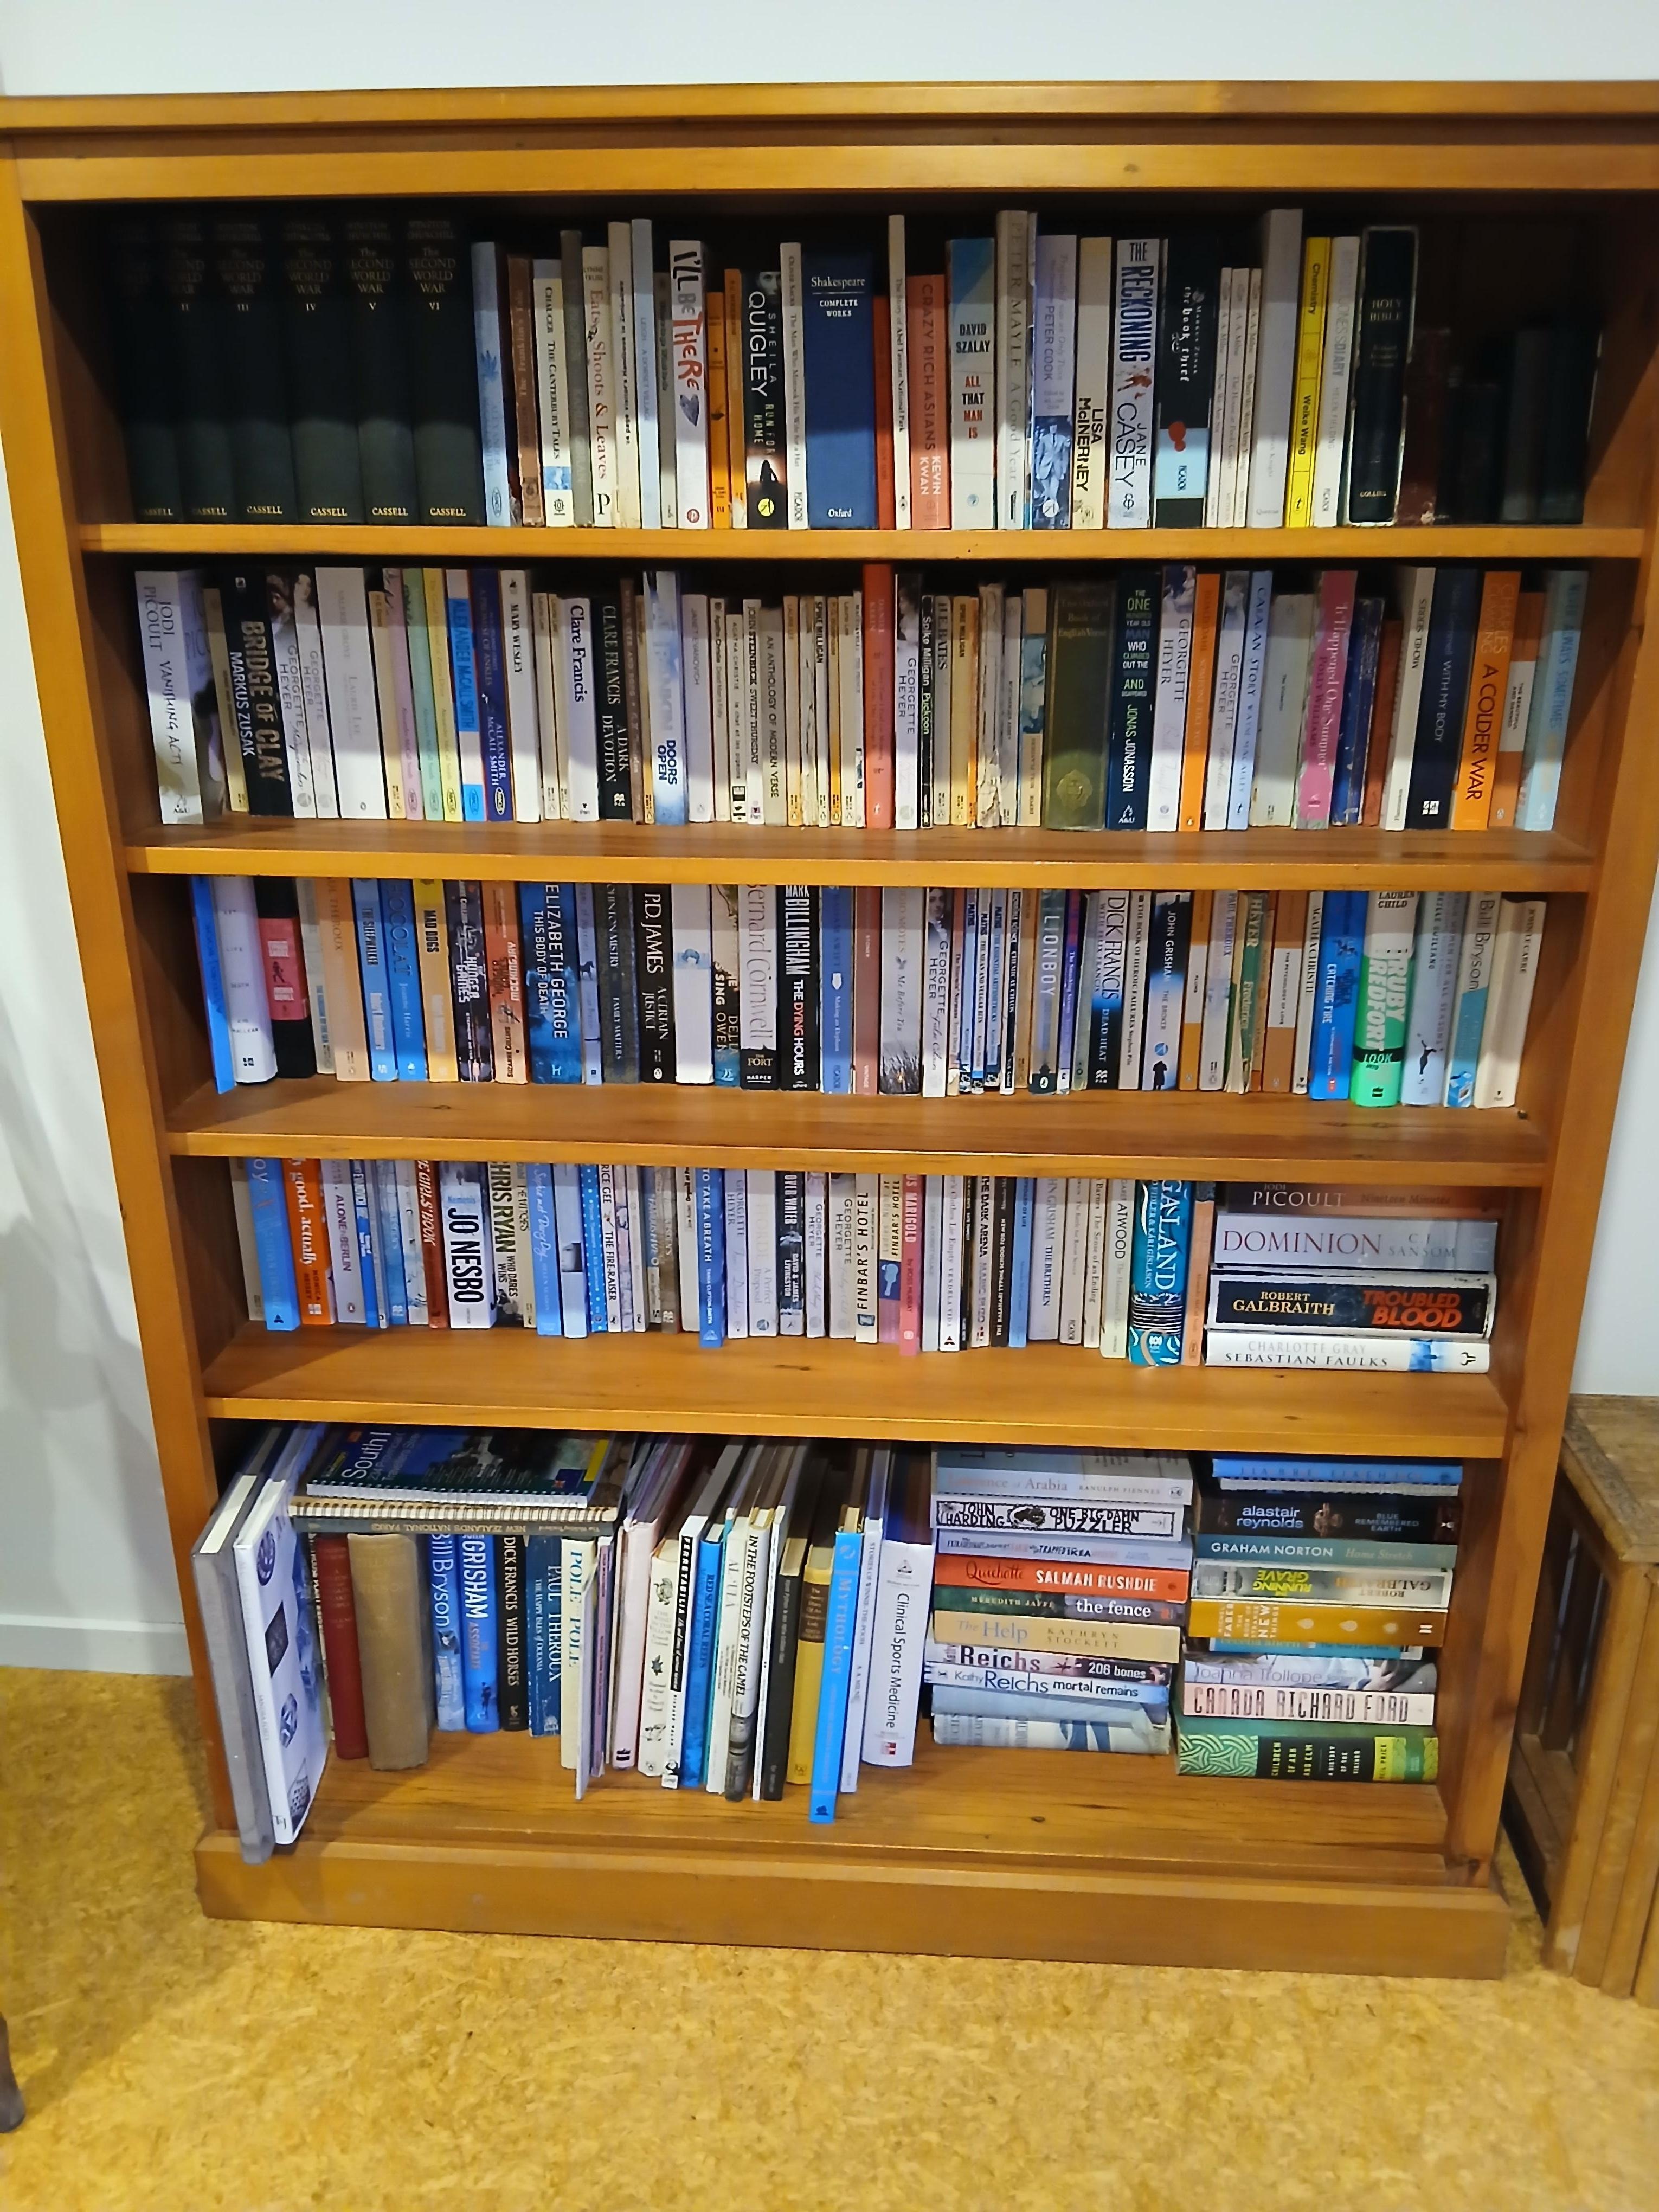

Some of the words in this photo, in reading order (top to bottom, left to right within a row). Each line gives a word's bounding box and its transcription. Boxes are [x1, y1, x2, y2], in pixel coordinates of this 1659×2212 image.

[1129, 242, 1148, 262] THE
[811, 276, 865, 288] Shakespeare
[1308, 263, 1321, 315] Chemistry
[429, 302, 440, 310] VI
[1120, 266, 1154, 362] RECKONING
[1369, 312, 1401, 321] BIBLE
[1372, 299, 1402, 308] HOLY
[960, 324, 986, 336] DAVID
[1044, 305, 1055, 344] PETER
[749, 291, 767, 397] QUIGLEY
[956, 341, 990, 353] SZALAY
[965, 376, 981, 387] ALL
[1044, 348, 1054, 382] COOK
[962, 394, 984, 405] THAT
[964, 410, 982, 421] MAN
[968, 427, 978, 439] IS
[1091, 408, 1104, 444] LISA
[1297, 427, 1309, 456] Wang
[1076, 397, 1091, 492] McINERNEY
[1115, 403, 1137, 487] CASEY
[1135, 422, 1146, 466] JANE
[919, 456, 929, 495] KWAN
[932, 456, 941, 494] KEVIN
[247, 505, 282, 515] CASSELL
[143, 586, 163, 651] PICOULT
[161, 602, 175, 635] JODI
[570, 605, 582, 644] Clare
[602, 606, 616, 647] CLARE
[747, 606, 757, 631] JOHN
[748, 631, 758, 686] STEINBECK
[766, 636, 774, 650] AN
[572, 647, 588, 702] Francis
[1160, 640, 1173, 685] HEYER
[1174, 619, 1189, 702] GEORGETTE
[1482, 664, 1499, 679] A
[230, 652, 249, 709] MARKUS
[280, 664, 292, 709] HEYER
[287, 645, 304, 728] GEORGETTE
[605, 652, 621, 704] FRANCIS
[767, 653, 776, 710] ANTHOLOGY
[1124, 679, 1143, 689] AND
[1218, 671, 1229, 712] HEYER
[1225, 654, 1240, 729] GEORGETTE
[750, 689, 758, 719] SWEET
[898, 675, 907, 718] HEYER
[907, 658, 917, 735] GEORGETTE
[237, 713, 255, 756] ZUSAK
[769, 713, 777, 726] OF
[1126, 704, 1138, 737] JONAS
[1471, 683, 1497, 754] COLDER
[750, 721, 759, 765] THURSDAY
[769, 730, 779, 768] MODERN
[657, 745, 667, 780] OPEN
[666, 740, 678, 785] DOORS
[1123, 739, 1135, 792] JONASSON
[770, 771, 780, 798] VERSE
[1466, 759, 1486, 800] WAR
[533, 911, 544, 934] THIS
[644, 893, 662, 919] P.D.
[1105, 897, 1126, 936] DICK
[545, 884, 563, 972] ELIZABETH
[785, 899, 811, 975] BILLINGHAM
[535, 936, 546, 964] BODY
[640, 922, 664, 974] JAMES
[1040, 915, 1060, 996] LIONBOY
[536, 966, 548, 979] OF
[928, 958, 938, 999] HEYER
[937, 940, 948, 1015] GEORGETTE
[1101, 940, 1123, 1000] FRANCIS
[538, 982, 549, 1014] DEATH
[793, 979, 803, 1001] THE
[1366, 959, 1387, 1051] REDFORT
[1386, 958, 1408, 1023] RUBY
[550, 978, 568, 1039] GEORGE
[793, 1002, 803, 1036] DYING
[1100, 1008, 1109, 1034] DEAD
[793, 1038, 804, 1076] HOURS
[1098, 1038, 1108, 1062] HEAT
[727, 1193, 736, 1225] HEYER
[1096, 1183, 1104, 1210] Barnes
[1252, 1192, 1346, 1207] PICOULT
[844, 1198, 852, 1264] GEORGETTE
[858, 1192, 869, 1237] HOTEL
[1115, 1203, 1128, 1259] ATWOOD
[605, 1231, 613, 1246] THE
[835, 1213, 844, 1251] HEYER
[1093, 1232, 1101, 1253] Sense
[1223, 1230, 1381, 1255] DOMINION
[1044, 1245, 1053, 1262] THE
[1092, 1255, 1101, 1264] of
[1092, 1265, 1098, 1275] an
[606, 1246, 618, 1301] FIRE-RAISER
[857, 1243, 869, 1310] FINBAR'S
[1043, 1263, 1053, 1307] BRETHREN
[1089, 1276, 1100, 1303] Ending
[1233, 1300, 1335, 1315] GALBRAITH
[1261, 1291, 1311, 1301] ROBERT
[1363, 1290, 1461, 1308] TROUBLED
[1372, 1307, 1462, 1328] BLOOD
[1225, 1353, 1317, 1365] SEBASTIAN
[1326, 1355, 1388, 1367] FAULKS
[946, 1514, 1005, 1527] HARDING
[959, 1503, 994, 1515] JOHN
[1236, 1516, 1304, 1529] reynolds
[1242, 1505, 1300, 1517] alastair
[503, 1536, 516, 1560] DICK
[748, 1535, 758, 1548] IN
[1211, 1542, 1270, 1554] GRAHAM
[1274, 1544, 1334, 1557] NORTON
[747, 1548, 757, 1570] THE
[1258, 1570, 1310, 1581] GRAVE
[461, 1540, 488, 1619] GRISHAM
[504, 1561, 518, 1611] FRANCIS
[570, 1551, 583, 1603] POLE
[678, 1537, 692, 1615] FERRETABILIA
[1036, 1570, 1094, 1587] SALMAN
[1098, 1573, 1157, 1592] RUSHDIE
[1252, 1581, 1313, 1593] RUNNING
[431, 1558, 454, 1628] Bryson
[741, 1570, 756, 1627] FOOTSTEPS
[1076, 1599, 1104, 1613] the
[1108, 1602, 1152, 1618] fence
[894, 1592, 910, 1634] Clinical
[1258, 1605, 1270, 1638] NEW
[506, 1617, 518, 1643] WILD
[569, 1618, 581, 1668] POLE
[739, 1628, 750, 1642] OF
[1047, 1628, 1120, 1639] KATHRYN
[1047, 1637, 1120, 1649] STOCKETT
[507, 1644, 519, 1687] HORSES
[738, 1643, 748, 1663] THE
[891, 1637, 905, 1674] Sports
[959, 1645, 1041, 1673] Reichs
[736, 1664, 747, 1696] CAMEL
[955, 1669, 984, 1684] Kathy
[984, 1671, 1049, 1694] Reichs
[1088, 1662, 1111, 1676] 206
[1114, 1664, 1147, 1679] bones
[885, 1677, 902, 1728] Medicine
[1052, 1680, 1094, 1694] mortal
[1095, 1684, 1139, 1697] remains
[1194, 1686, 1265, 1717] CANADA
[1276, 1689, 1356, 1720] RICHARD
[1363, 1694, 1409, 1723] FORD
[1271, 1741, 1281, 1777] CHILDREN
